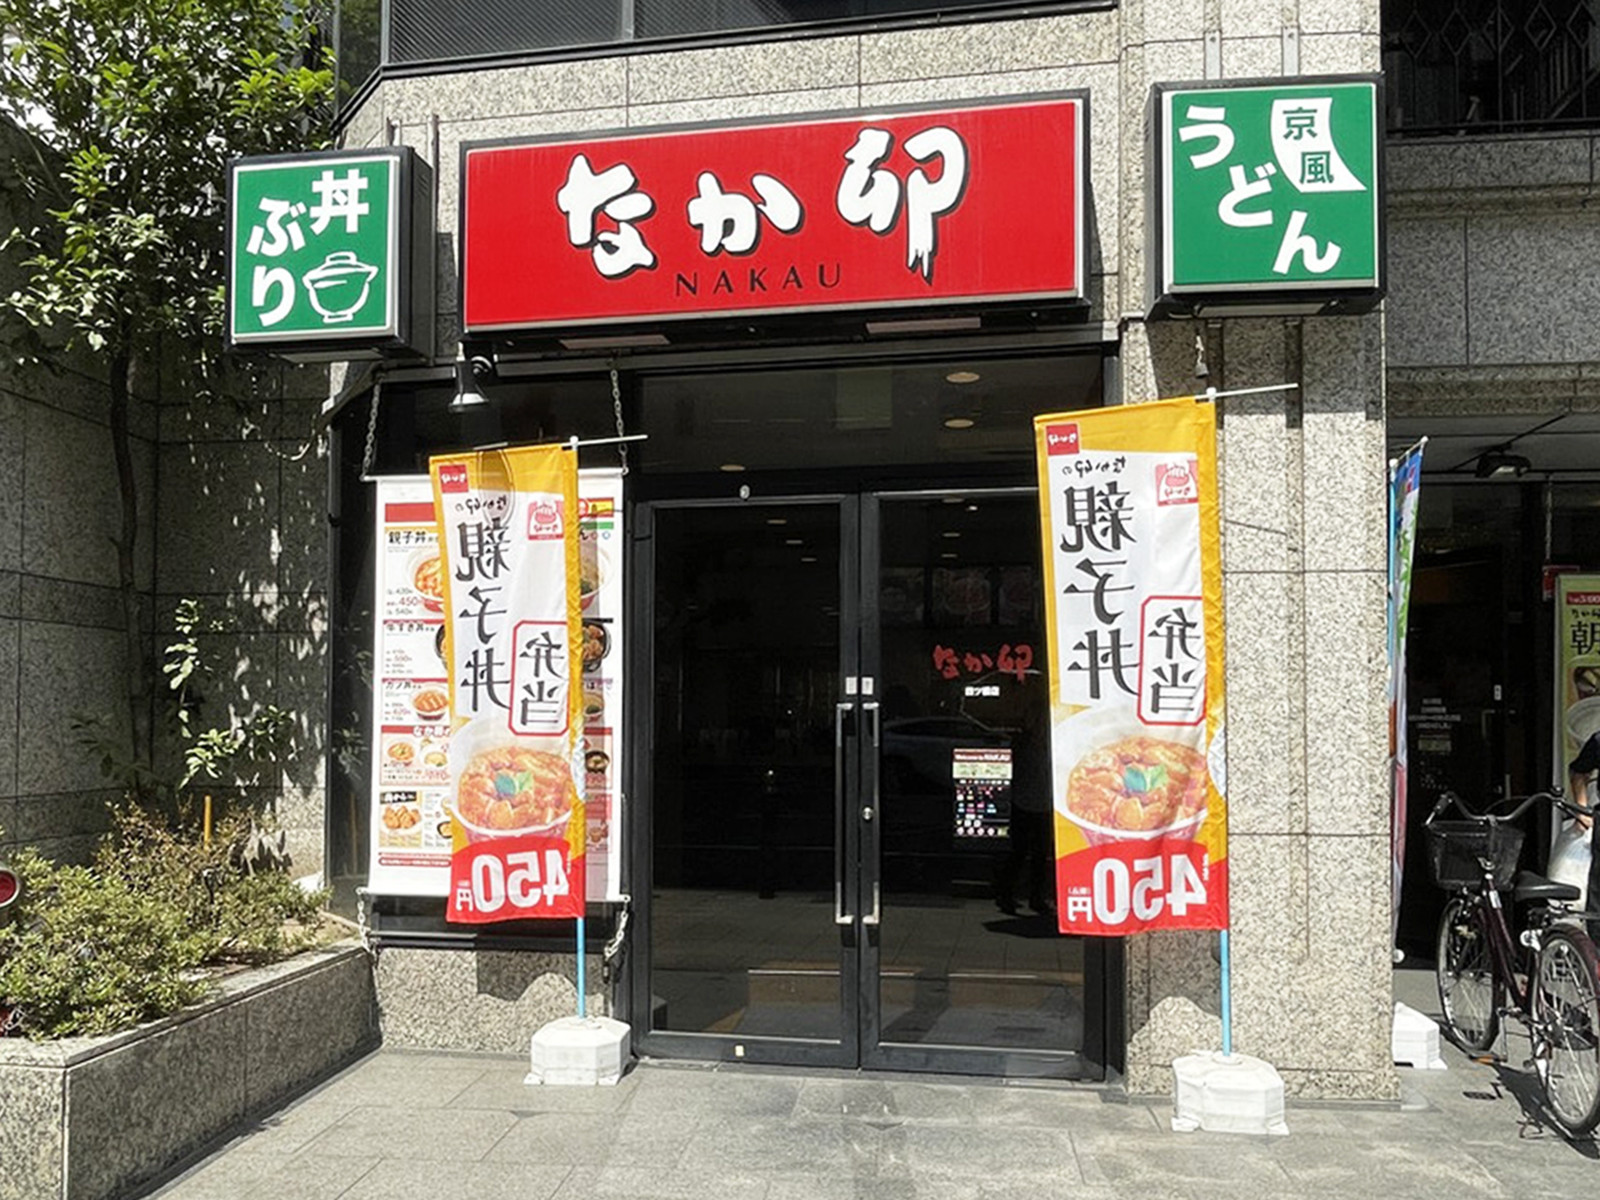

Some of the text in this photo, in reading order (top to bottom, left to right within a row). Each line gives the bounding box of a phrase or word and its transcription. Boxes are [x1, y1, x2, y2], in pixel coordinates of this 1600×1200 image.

[1283, 107, 1335, 184] 京風
[556, 127, 966, 278] なか卯
[1178, 105, 1342, 275] うどん
[677, 262, 841, 297] NAKAU
[933, 644, 1034, 682] なか卯
